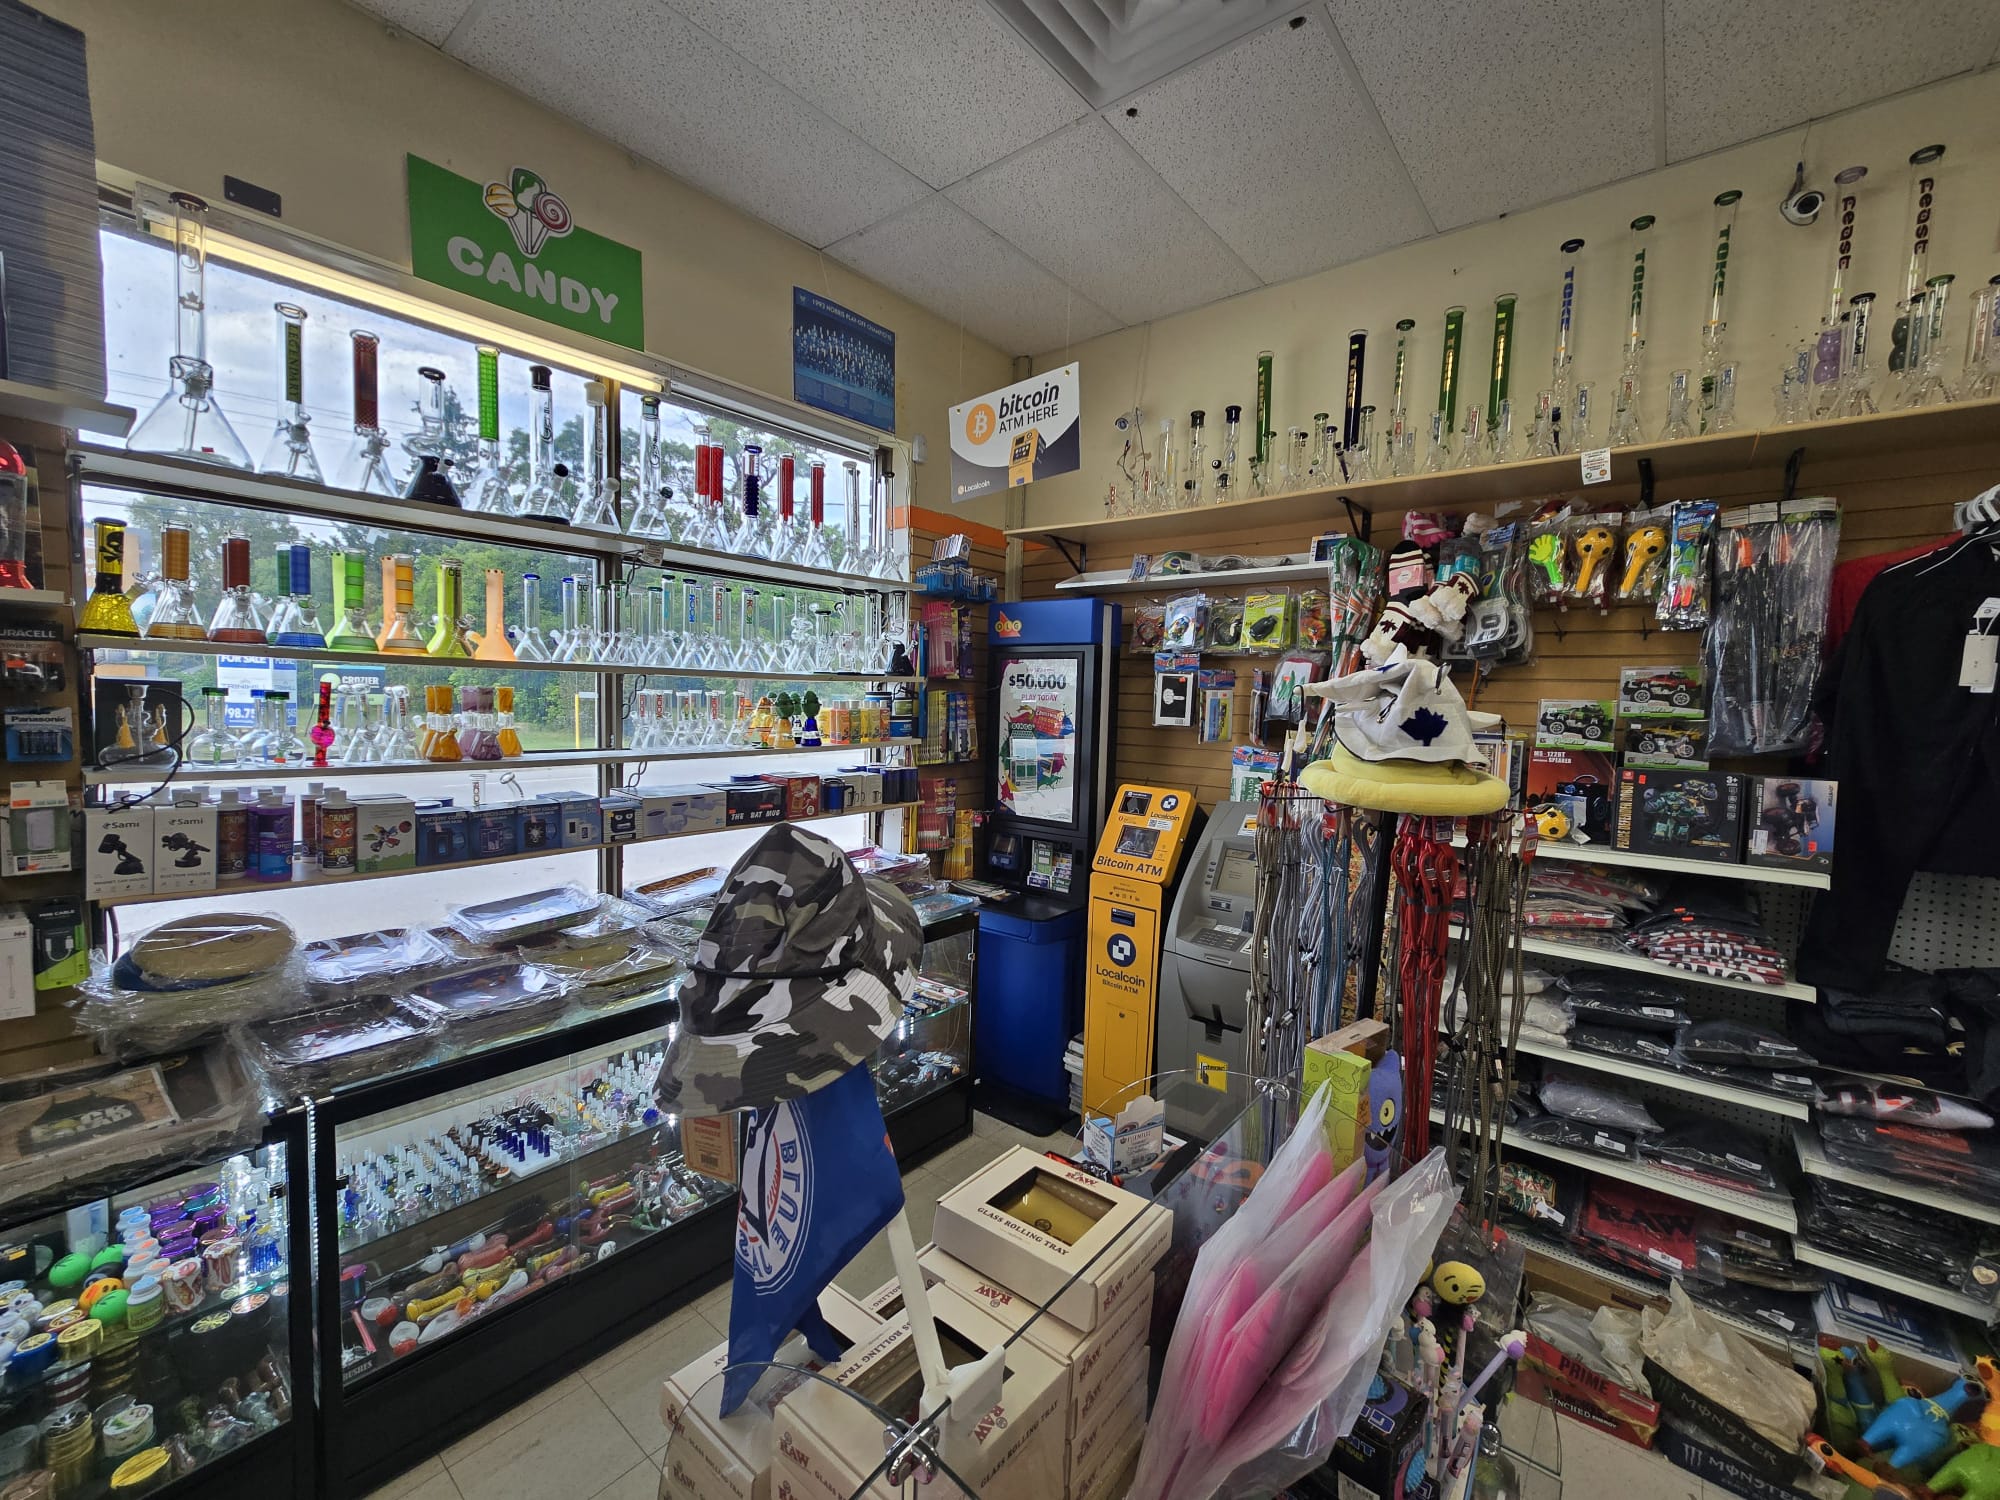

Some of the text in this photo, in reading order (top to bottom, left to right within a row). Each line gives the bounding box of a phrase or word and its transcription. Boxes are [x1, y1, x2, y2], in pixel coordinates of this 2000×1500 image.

[1712, 223, 1731, 298] TOKE
[446, 235, 619, 324] CANDY
[1631, 248, 1646, 318] TOKE
[1560, 266, 1575, 332] TOKE
[998, 381, 1060, 420] bitcoin
[999, 403, 1059, 434] ATM HERE
[342, 675, 380, 685] CROZIER
[11, 715, 67, 723] Panasonic
[177, 818, 204, 826] Sami
[731, 809, 780, 821] THE BAT MUG
[1150, 811, 1180, 821] Localcoin
[1616, 781, 1634, 849] PEACE DEFENDER ROBOT
[1096, 855, 1163, 877] Bitcoin ATM
[1096, 963, 1145, 988] Localcoin
[1102, 978, 1138, 995] Bitcoin ATM
[1065, 1171, 1099, 1187] RAW
[977, 1206, 1070, 1257] GLASS ROLLING TRAY
[975, 1284, 1014, 1306] RAW
[1103, 1275, 1126, 1310] RAW
[834, 1327, 903, 1384] ROLLING TRAY
[1559, 1354, 1609, 1396] PRIME
[974, 1403, 1005, 1446] RAW
[1680, 1392, 1778, 1466] MONSTER
[779, 1435, 811, 1468] RAW
[814, 1470, 837, 1497] GLASS
